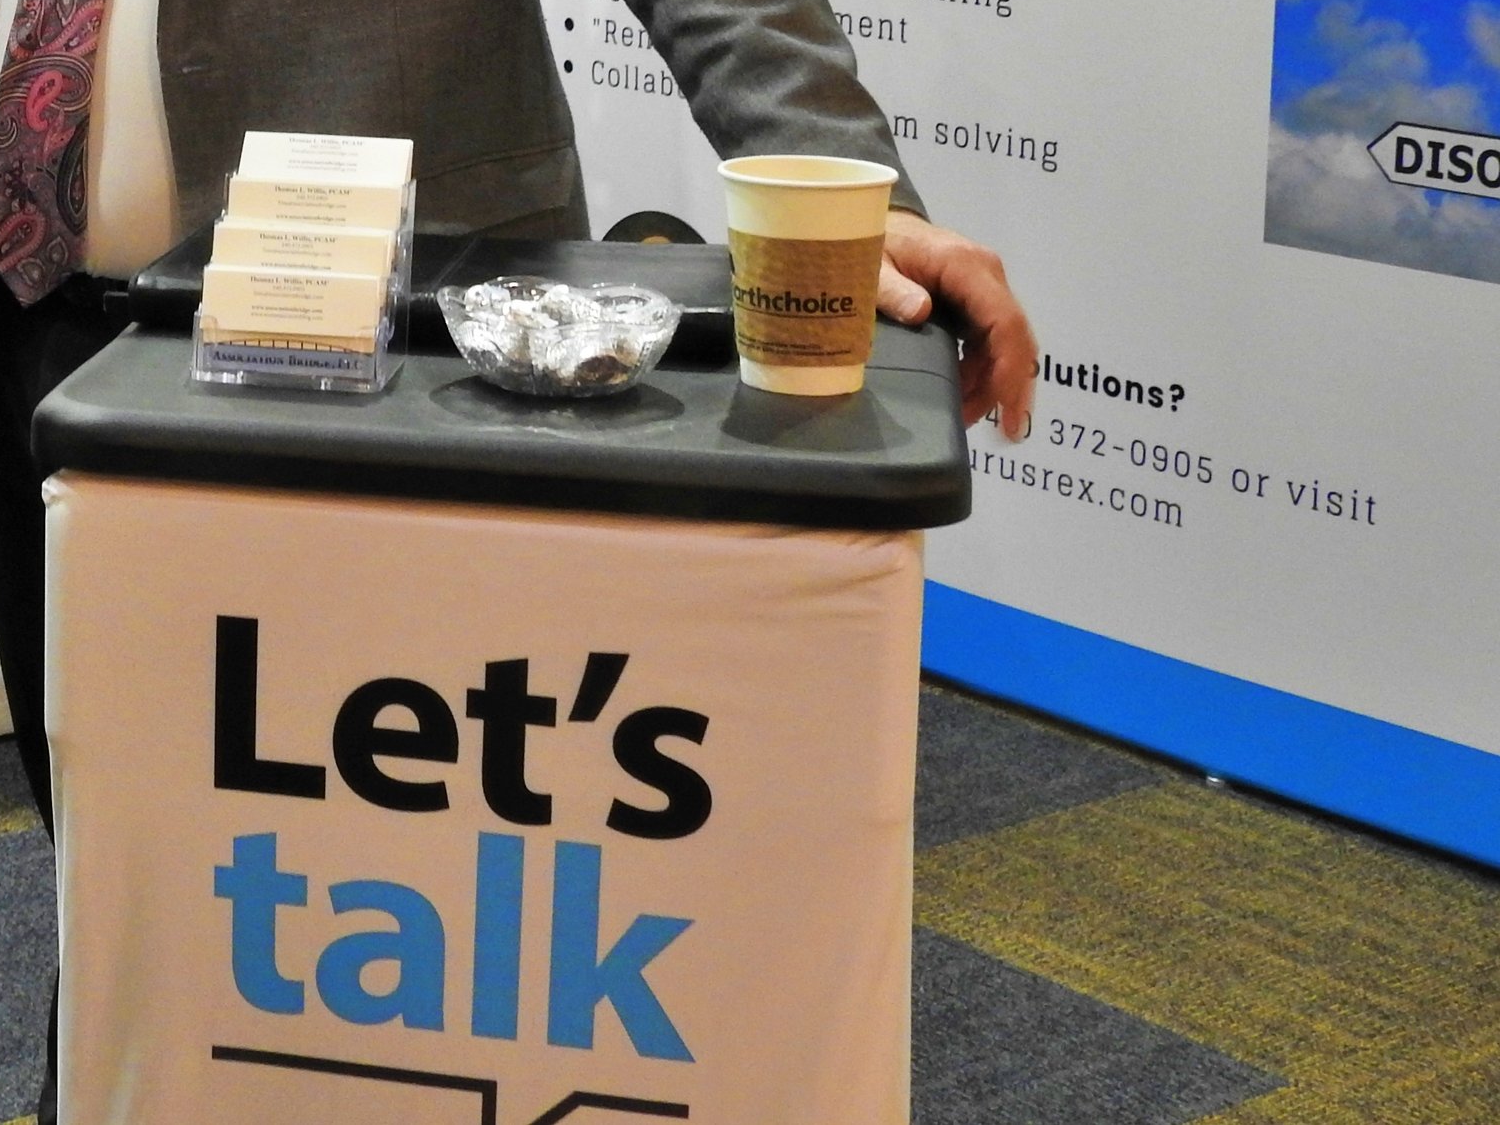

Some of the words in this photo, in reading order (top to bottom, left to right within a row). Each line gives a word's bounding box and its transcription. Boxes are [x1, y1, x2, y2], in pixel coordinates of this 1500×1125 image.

[933, 122, 1059, 173] solving
[1049, 418, 1213, 485] 372-0905
[1232, 466, 1270, 499] or
[1287, 480, 1378, 526] visit
[213, 614, 713, 840] Let's
[213, 831, 697, 1064] talk
